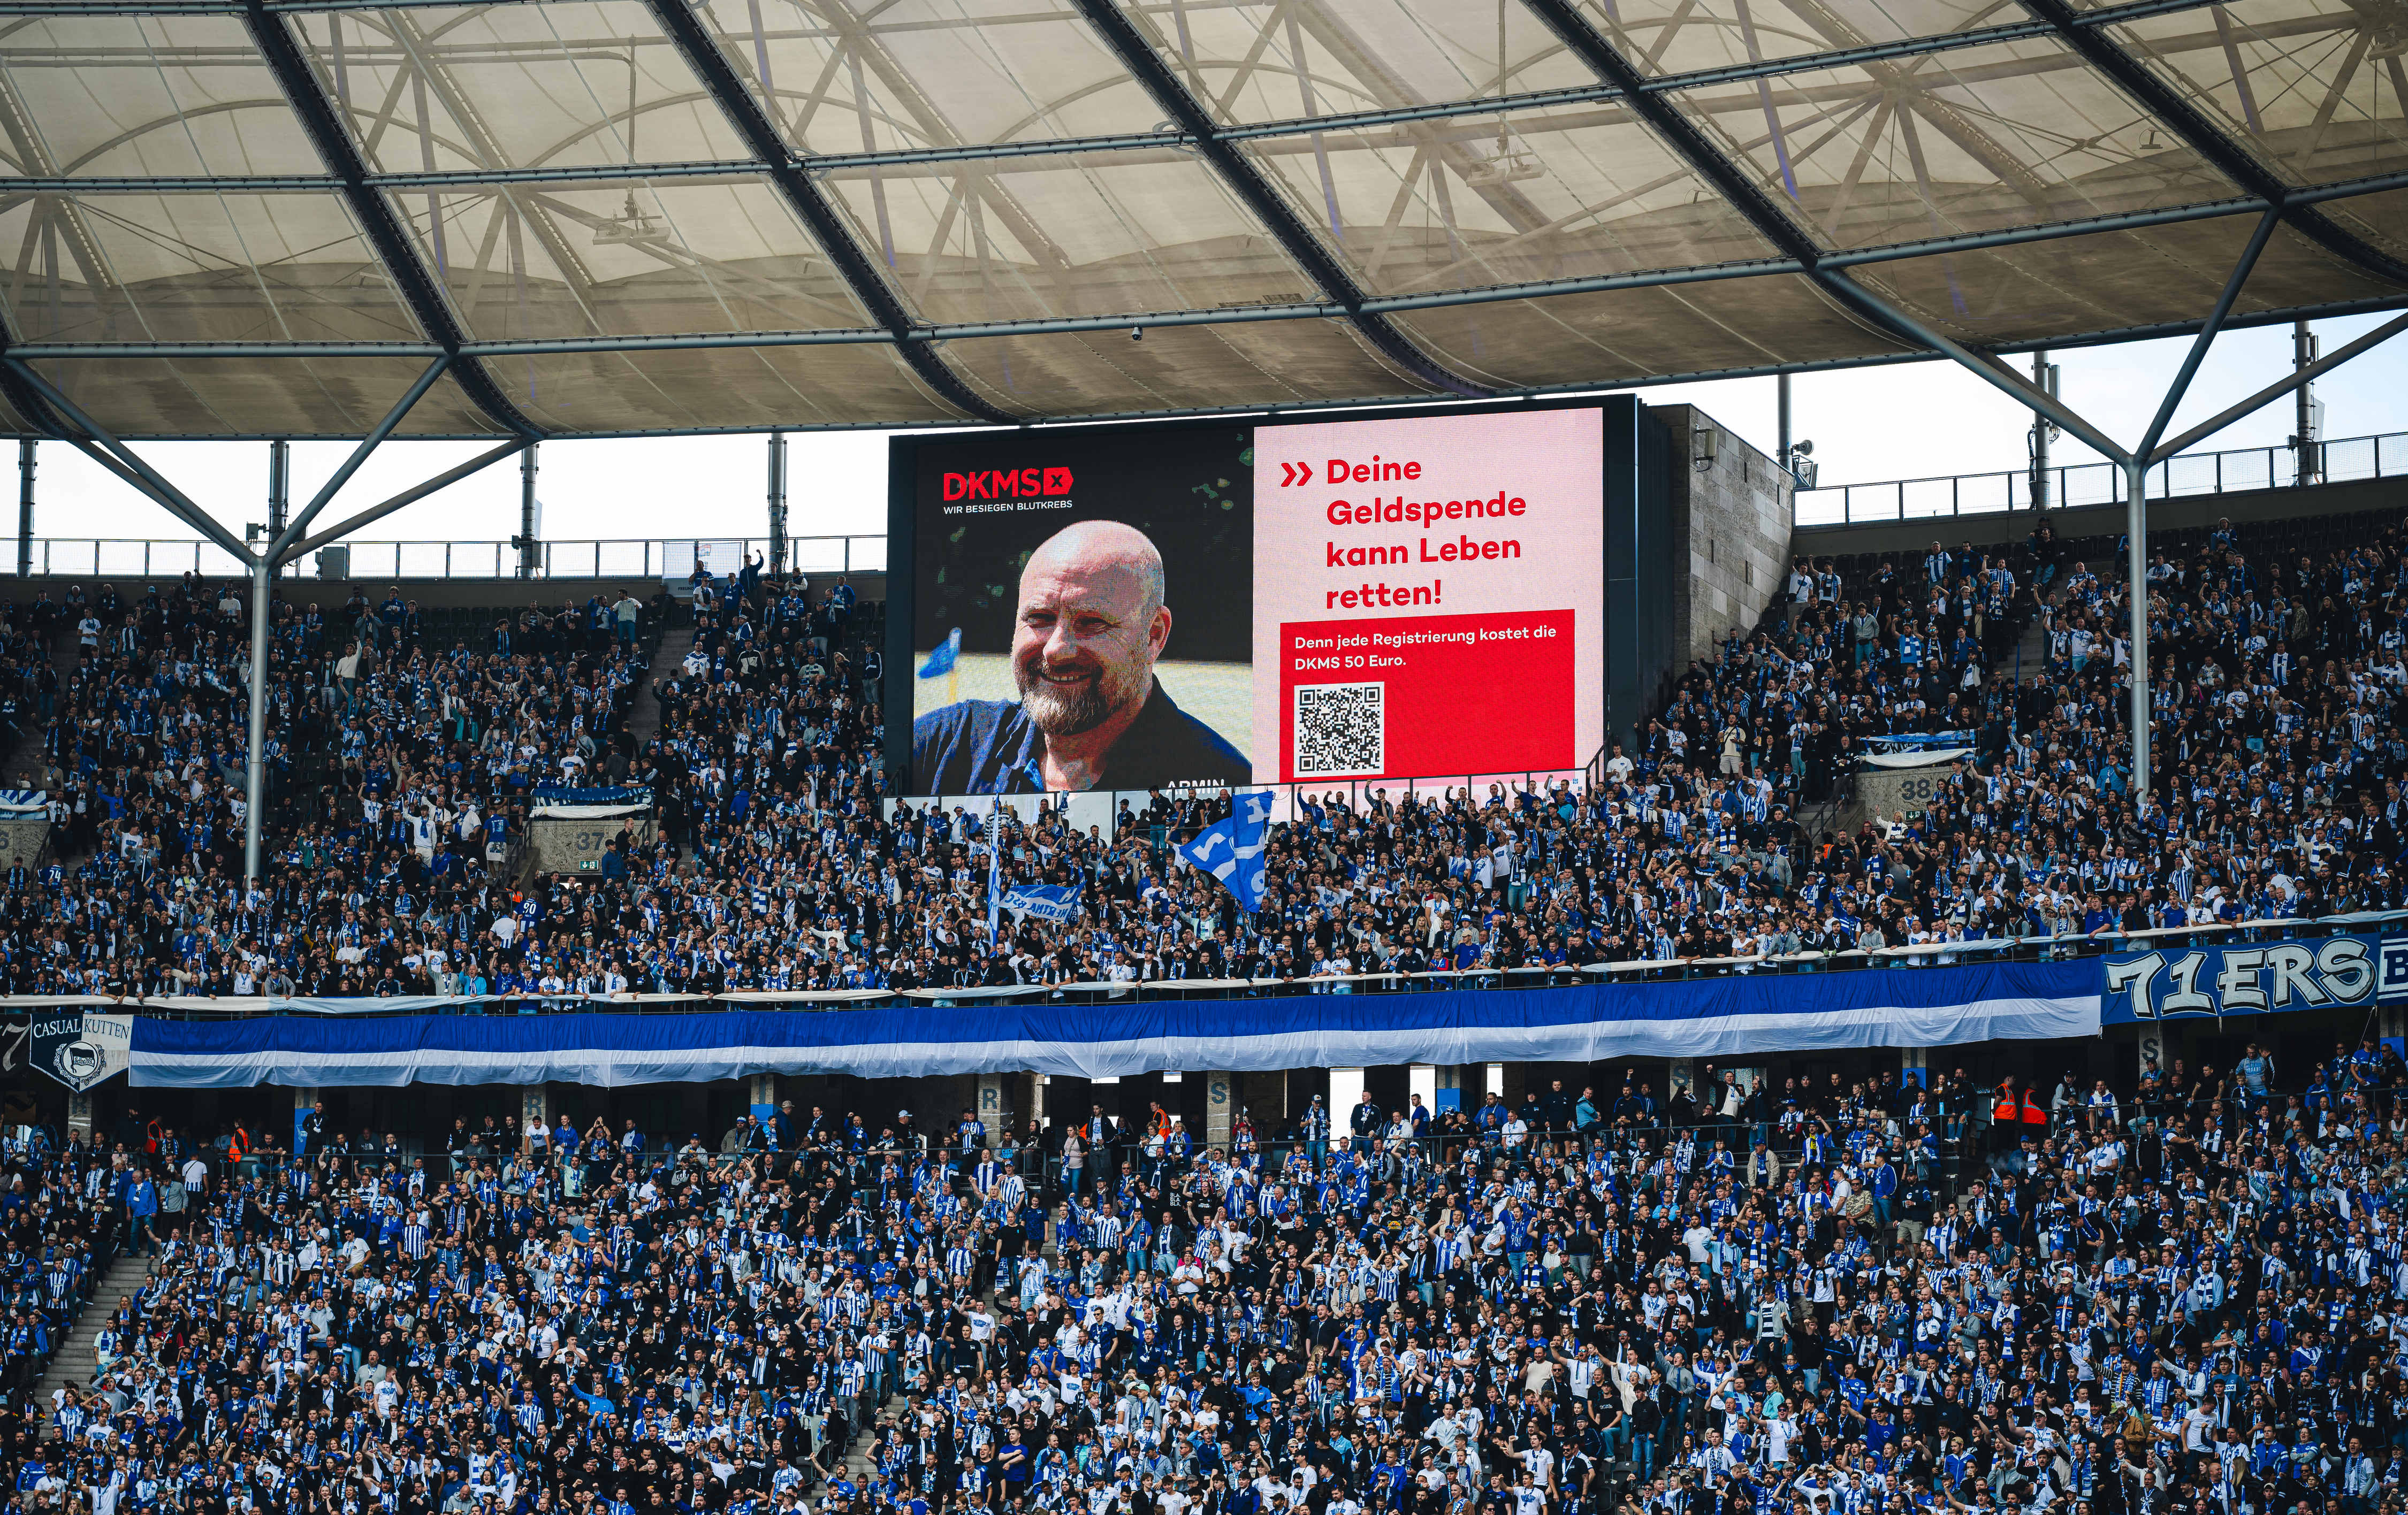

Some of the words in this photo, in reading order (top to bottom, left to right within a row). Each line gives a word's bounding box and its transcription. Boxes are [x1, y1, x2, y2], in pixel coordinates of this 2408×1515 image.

[1327, 455, 1421, 484] Deine
[943, 468, 1041, 501] DKMS
[943, 506, 963, 514] WIR
[966, 503, 1014, 513] BESIEGEN
[1017, 500, 1072, 510] BLUTKREBS
[1327, 491, 1526, 529] Geldspende
[1327, 541, 1408, 567] kann
[1420, 534, 1521, 563] Leben
[1327, 579, 1442, 609] retten!
[1295, 637, 1333, 649] Denn
[1336, 634, 1369, 651] jede
[1373, 630, 1475, 648] Registrierung
[1480, 627, 1529, 640] kostet
[1533, 625, 1557, 638] die
[1295, 656, 1340, 670] DKMS
[1345, 655, 1364, 668] 50
[1369, 655, 1406, 667] Euro.
[1165, 778, 1225, 795] ARMIN
[1901, 778, 1931, 800] 38
[577, 831, 605, 851] 37
[49, 870, 61, 882] 74
[523, 902, 537, 915] 90
[2104, 938, 2377, 1019] 71ERS
[33, 1019, 81, 1038] CASUAL
[83, 1018, 130, 1040] KUTTEN
[2142, 1038, 2159, 1062] S
[982, 1089, 997, 1110] R
[1210, 1082, 1227, 1104] S
[527, 1095, 542, 1115] R
